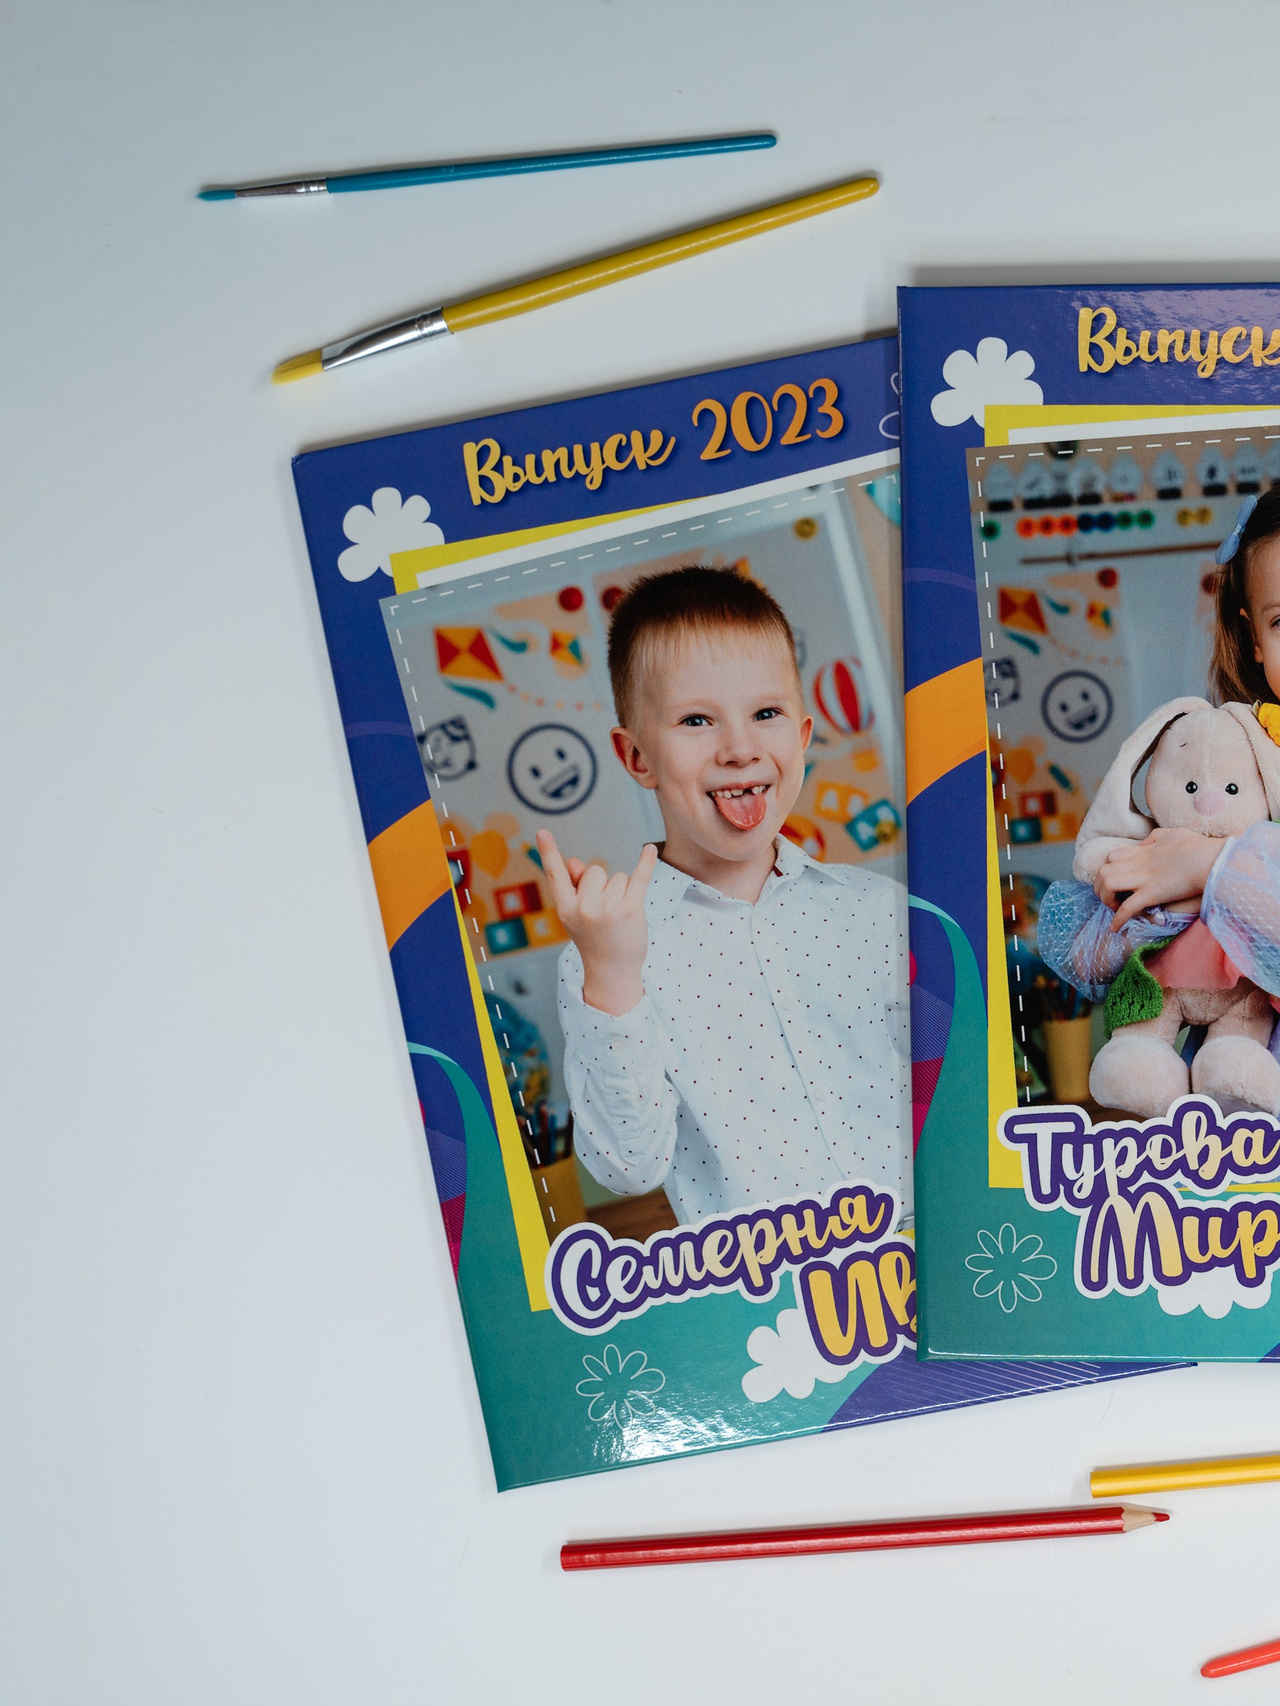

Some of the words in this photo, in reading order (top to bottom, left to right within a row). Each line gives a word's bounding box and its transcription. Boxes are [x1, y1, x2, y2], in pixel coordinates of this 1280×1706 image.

[462, 430, 677, 506] Выпуск
[691, 377, 845, 461] 2023
[558, 1193, 887, 1322] Семерня
